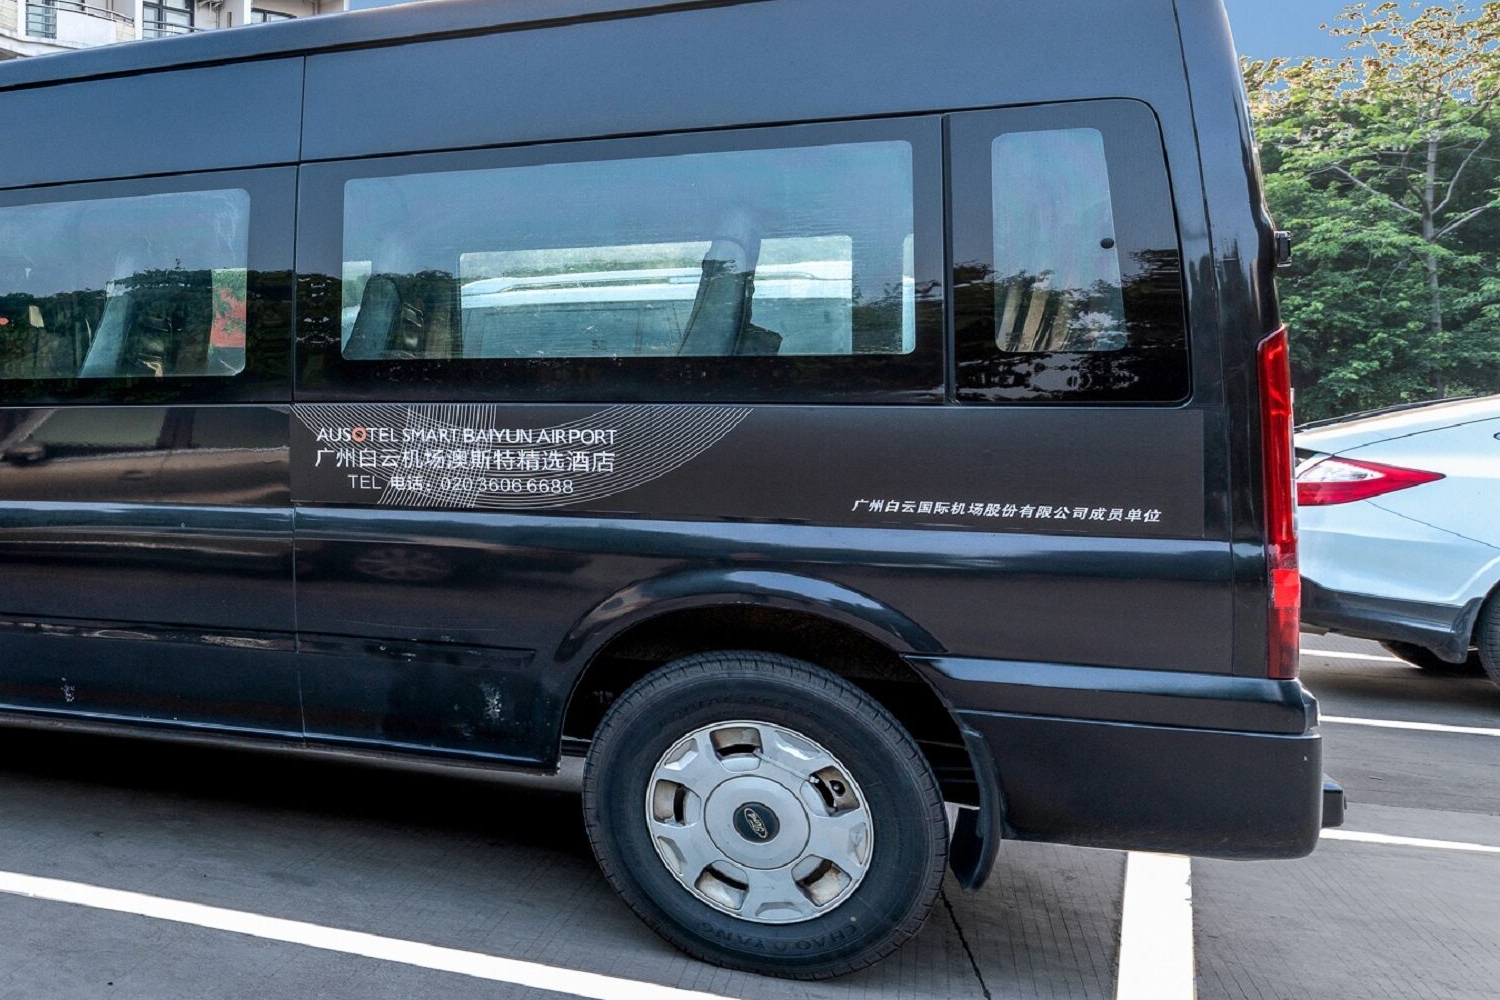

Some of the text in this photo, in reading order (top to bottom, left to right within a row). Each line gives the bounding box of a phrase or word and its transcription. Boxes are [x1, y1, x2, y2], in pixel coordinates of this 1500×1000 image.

[316, 425, 617, 445] AUSOTEL SMART BAIYUN AIRPORT
[315, 447, 616, 472] 广州白云机场澳斯特精选酒店
[348, 474, 381, 490] TEL
[441, 476, 473, 491] 020
[478, 477, 523, 492] 3606
[527, 479, 574, 494] 6688
[851, 498, 1163, 524] 广州白云国际机场股份有限公司成员单位
